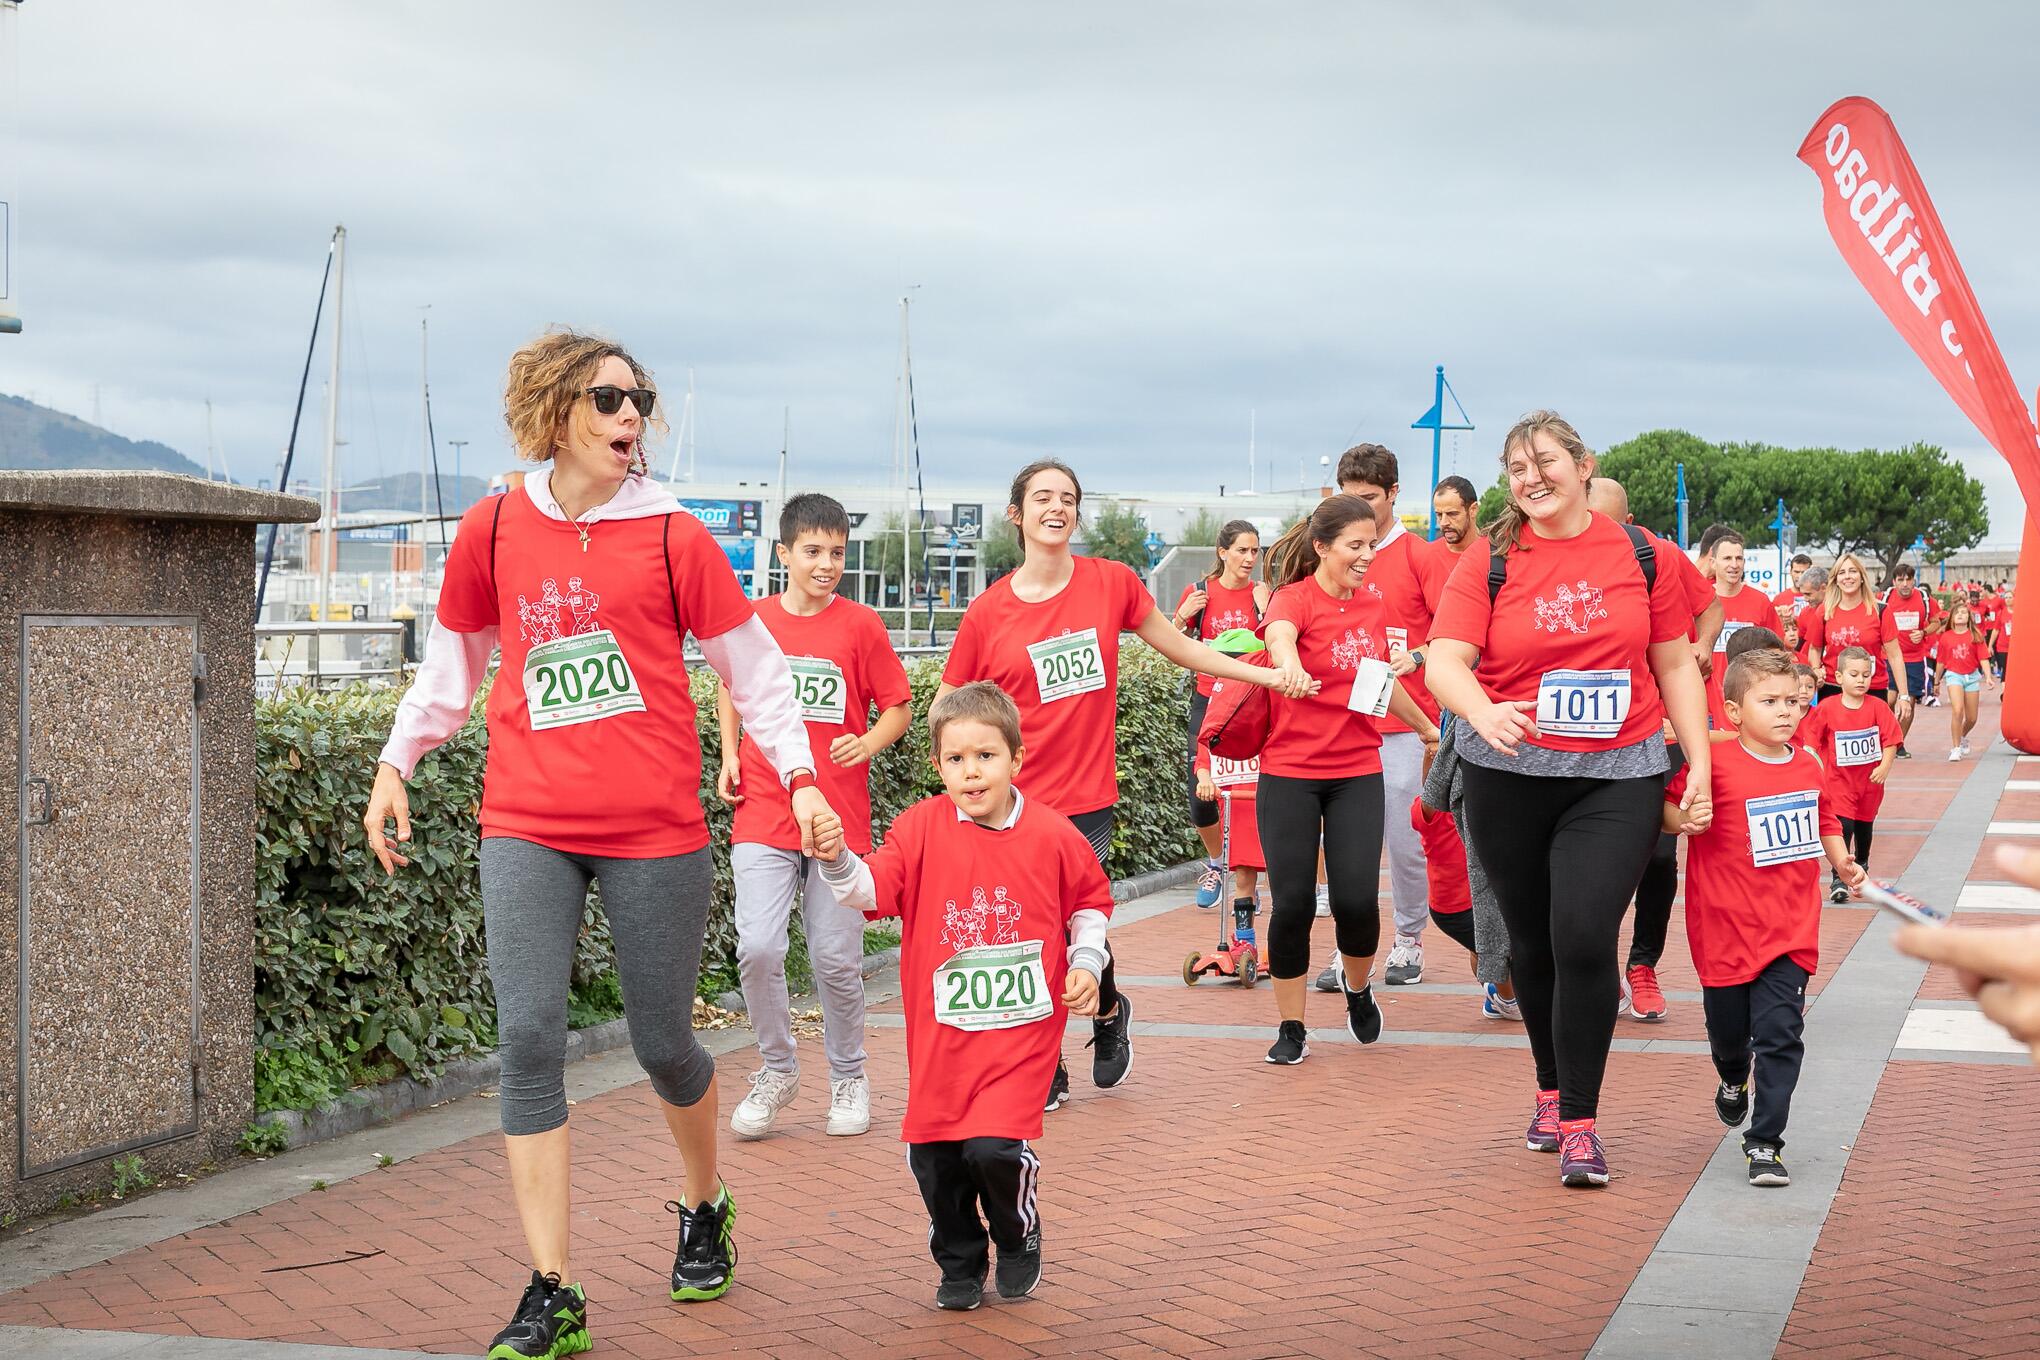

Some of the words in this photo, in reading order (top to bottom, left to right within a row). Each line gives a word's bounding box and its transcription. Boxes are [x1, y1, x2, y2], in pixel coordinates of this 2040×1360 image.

[536, 653, 631, 707] 2020
[1043, 647, 1098, 686] 2052
[1550, 689, 1618, 721] 1011
[1842, 737, 1876, 757] 1009
[1760, 810, 1813, 847] 1011
[947, 965, 1036, 1010] 2020
